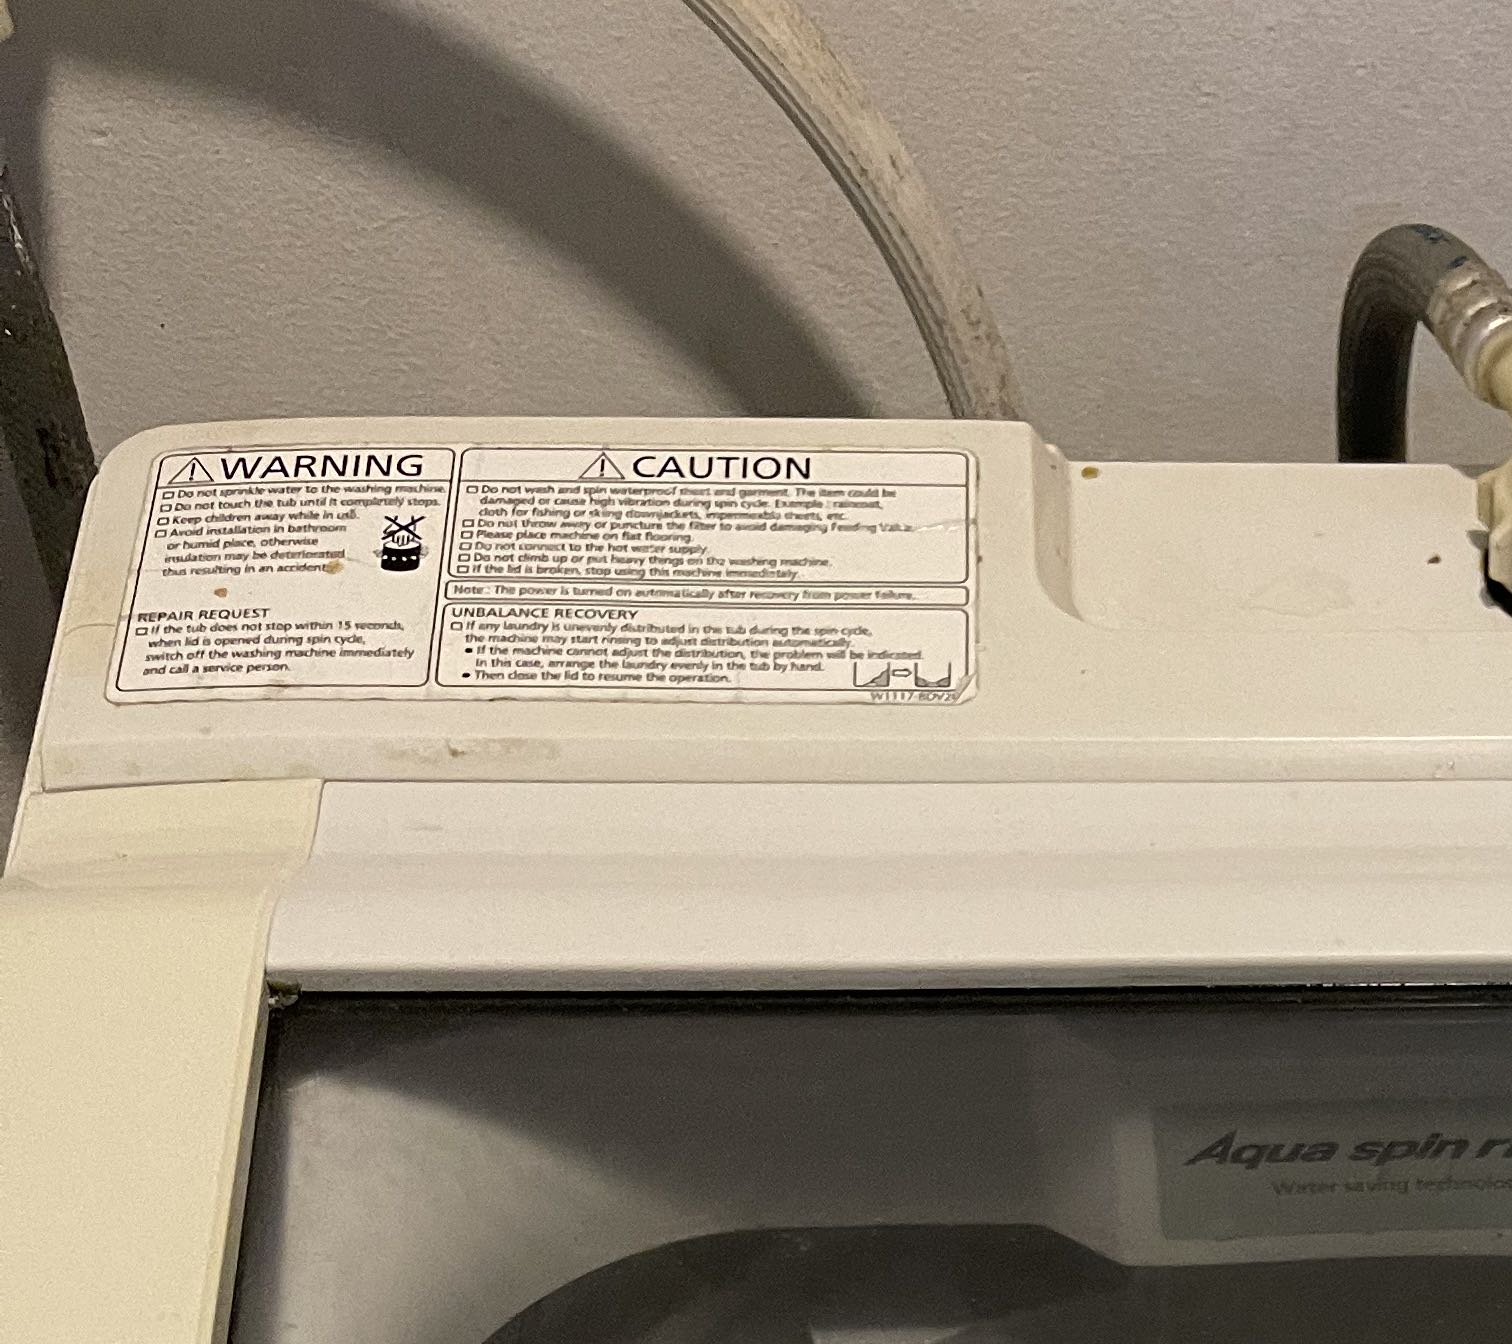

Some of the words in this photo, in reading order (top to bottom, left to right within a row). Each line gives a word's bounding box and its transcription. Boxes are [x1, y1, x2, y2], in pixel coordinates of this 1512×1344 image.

[221, 455, 423, 479] WARNING
[632, 455, 811, 480] CAUTION
[138, 611, 193, 622] REPAIR
[199, 608, 270, 619] REQUEST
[452, 608, 549, 618] UNBALANCE
[554, 609, 639, 619] RECOVERY
[1183, 1129, 1338, 1169] Aqua
[1349, 1132, 1468, 1166] spin
[1273, 1179, 1337, 1195] Water
[1344, 1176, 1409, 1194] saving
